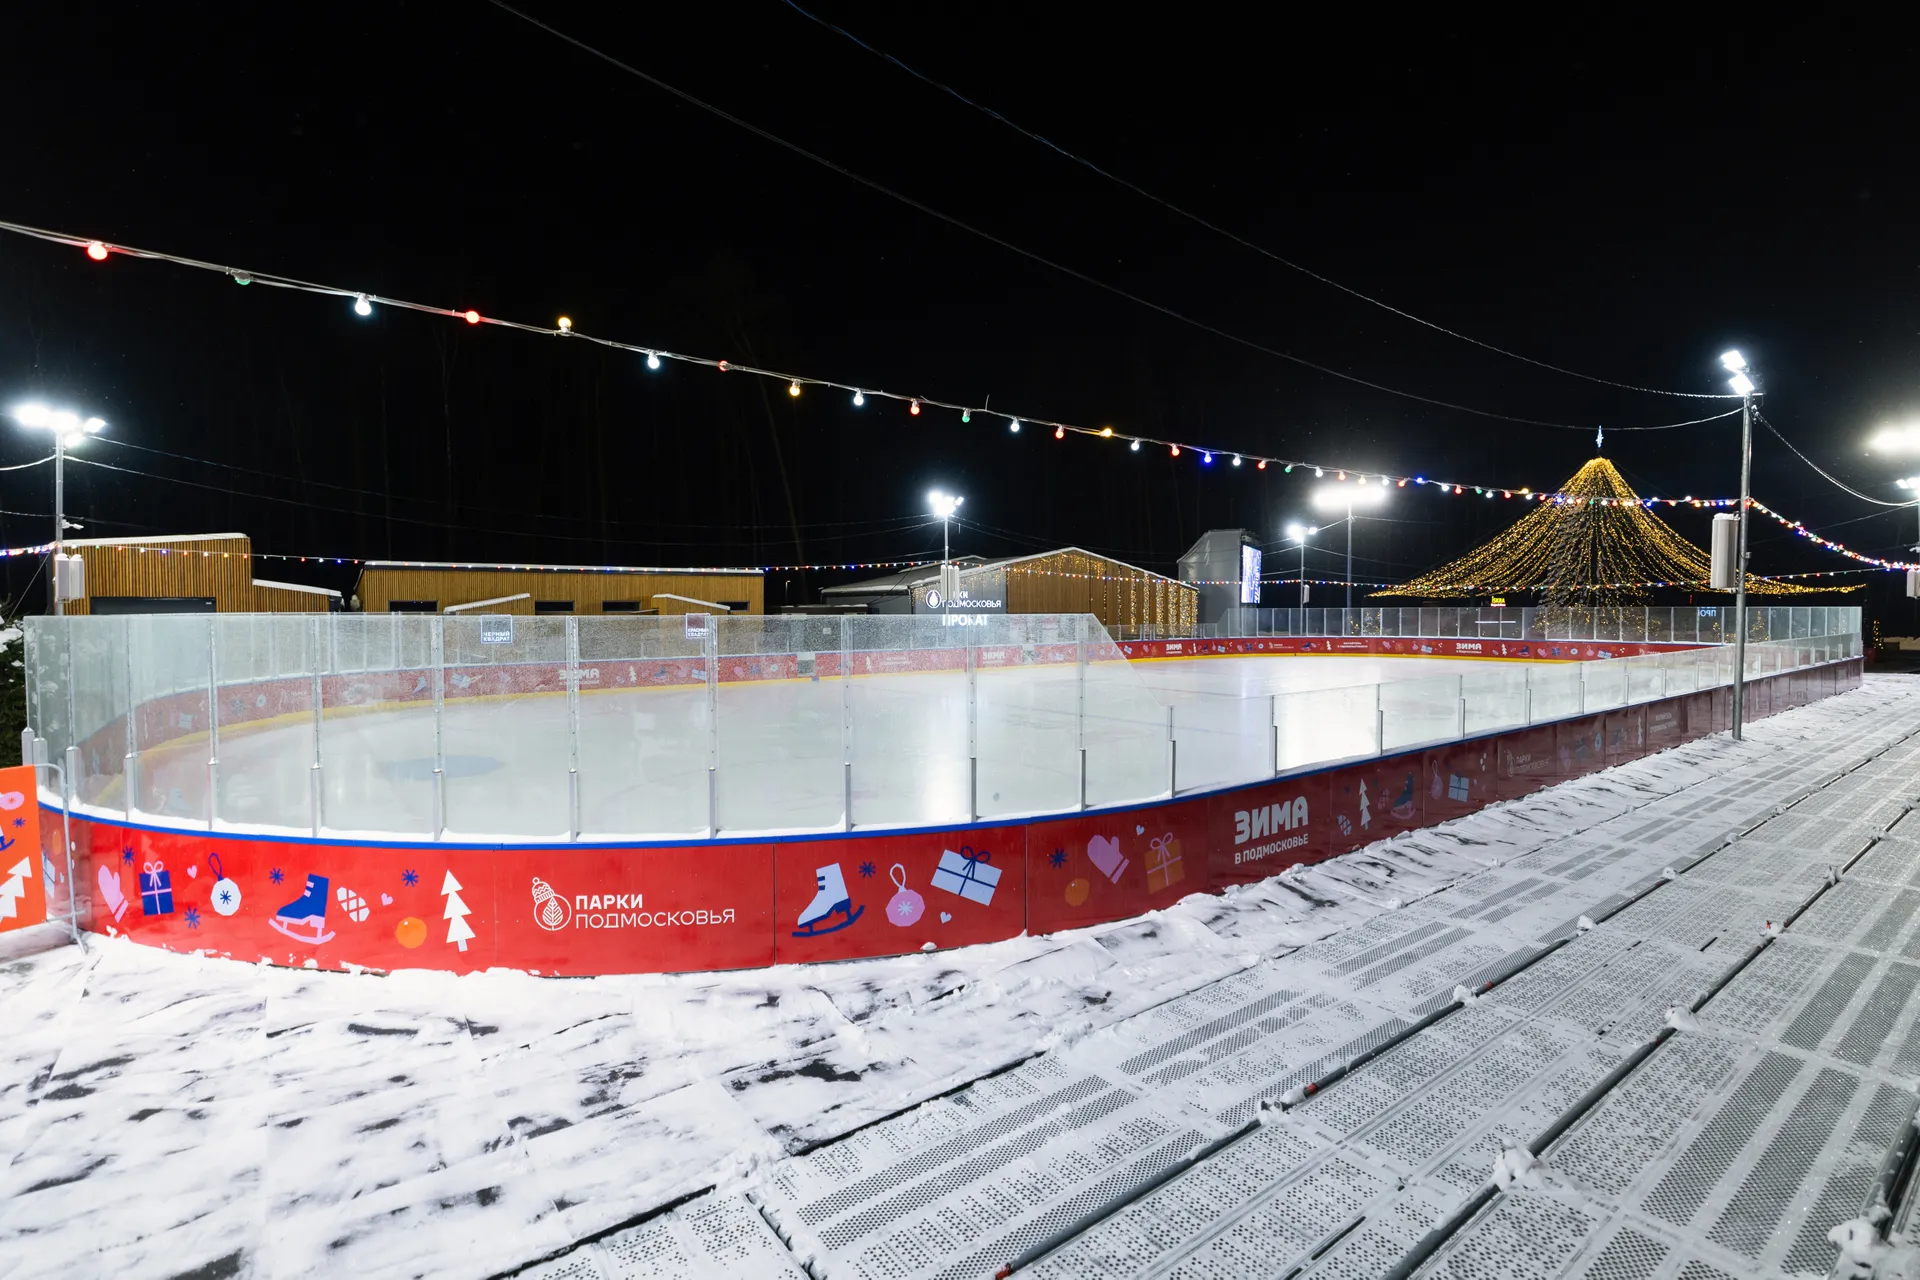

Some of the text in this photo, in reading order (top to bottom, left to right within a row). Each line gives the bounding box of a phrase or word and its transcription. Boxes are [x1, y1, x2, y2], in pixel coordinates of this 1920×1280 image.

[1456, 642, 1482, 651] ЗИМА
[1234, 796, 1309, 845] ЗИМА
[1234, 833, 1309, 865] В ПОДМОСКОВЬЕ
[575, 894, 643, 910] ПАРКИ
[575, 908, 735, 929] ПОДМОСКОВЬЯ
